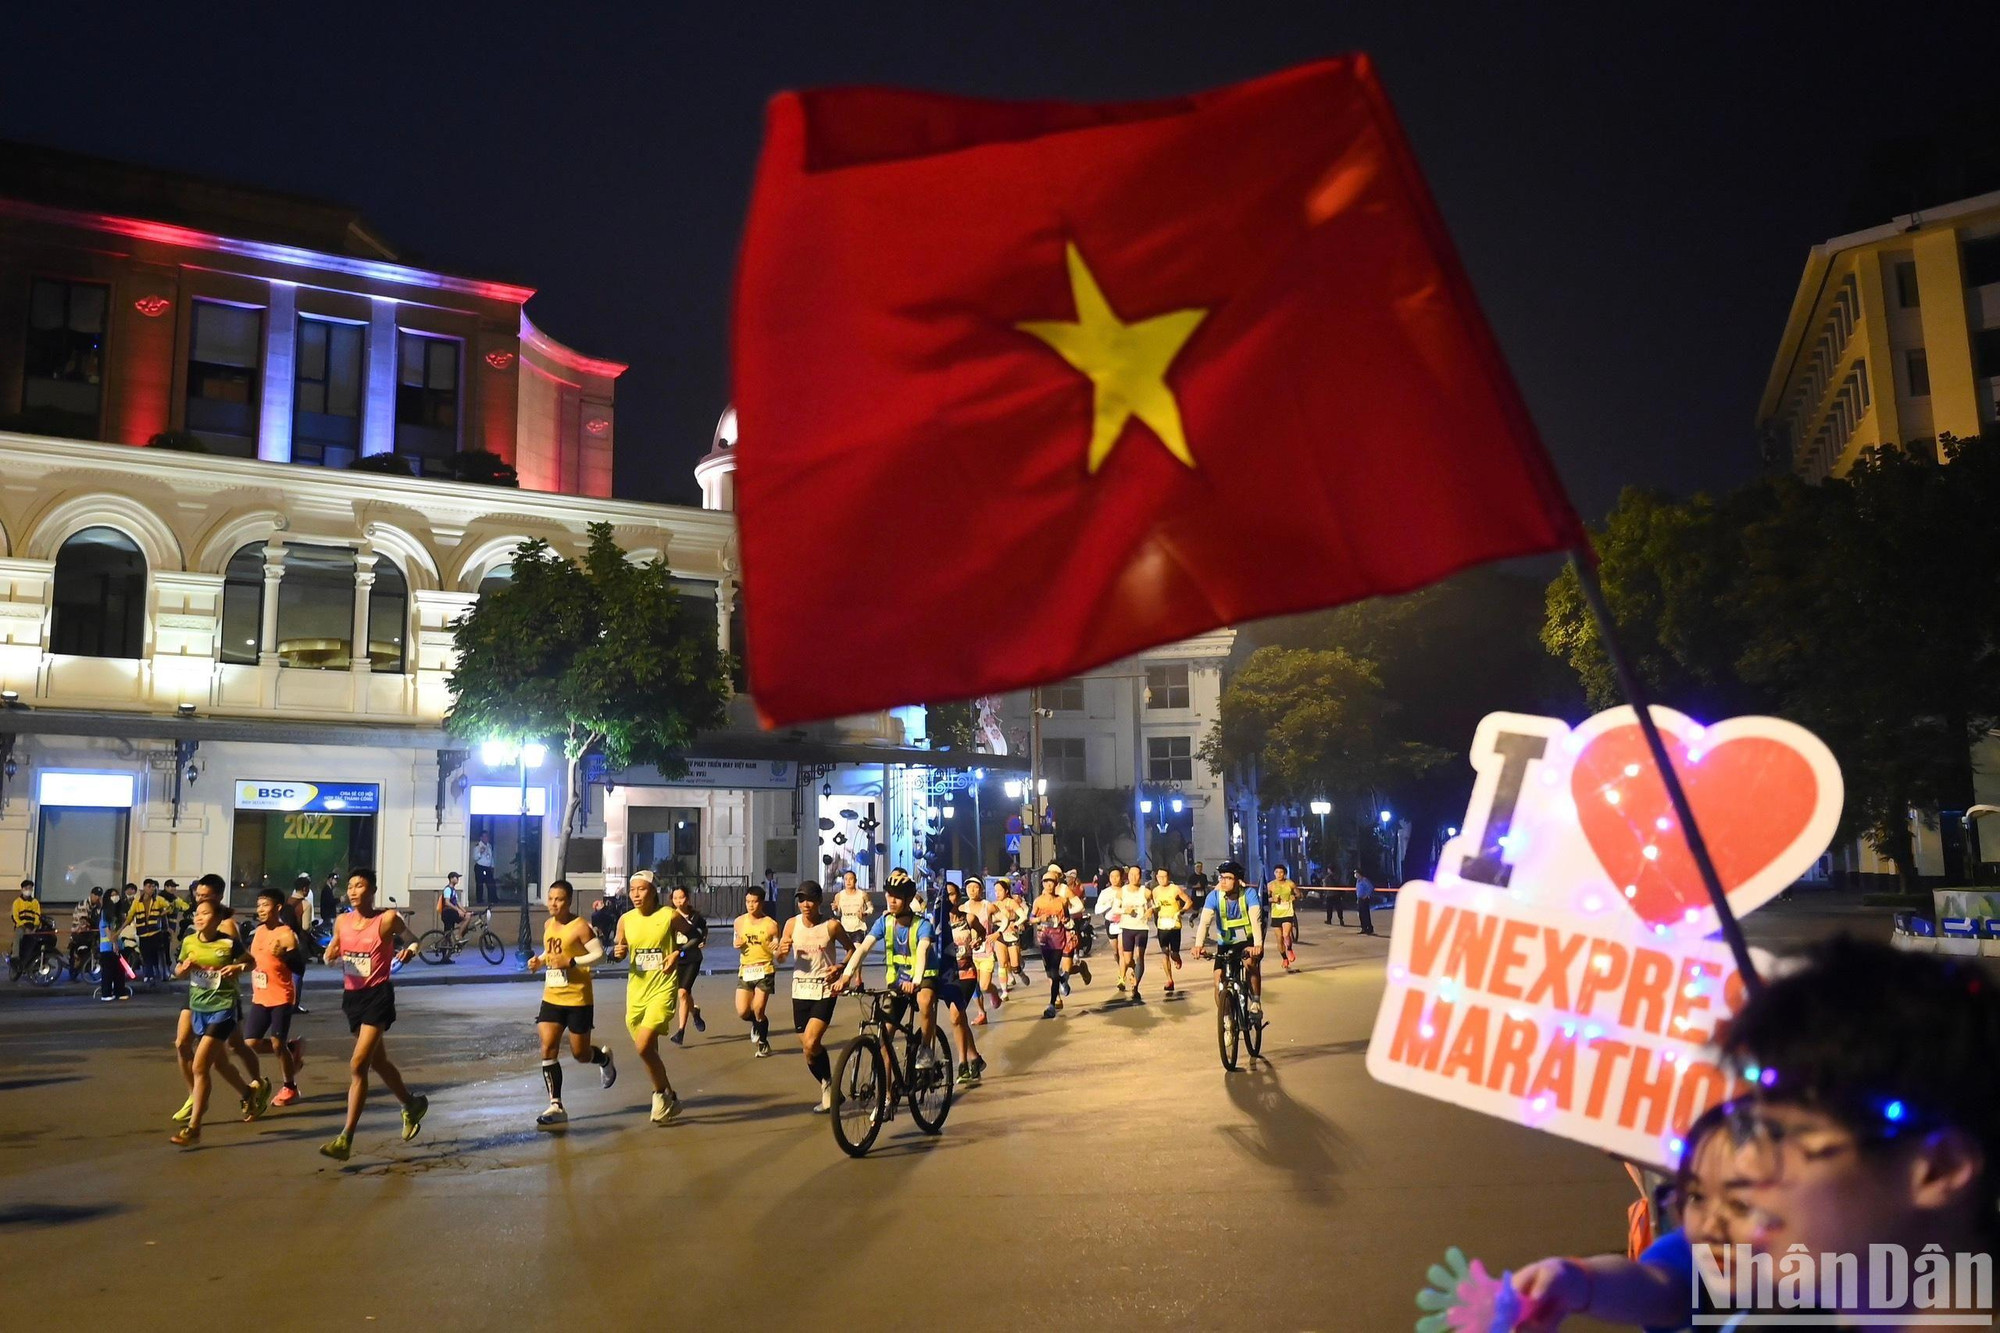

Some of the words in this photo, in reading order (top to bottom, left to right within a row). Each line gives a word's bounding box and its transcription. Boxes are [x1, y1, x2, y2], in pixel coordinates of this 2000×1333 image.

[258, 788, 295, 799] BSC
[1460, 731, 1548, 888] I
[283, 815, 334, 840] 2022
[546, 937, 562, 954] 18
[1388, 989, 1752, 1137] MARATHO
